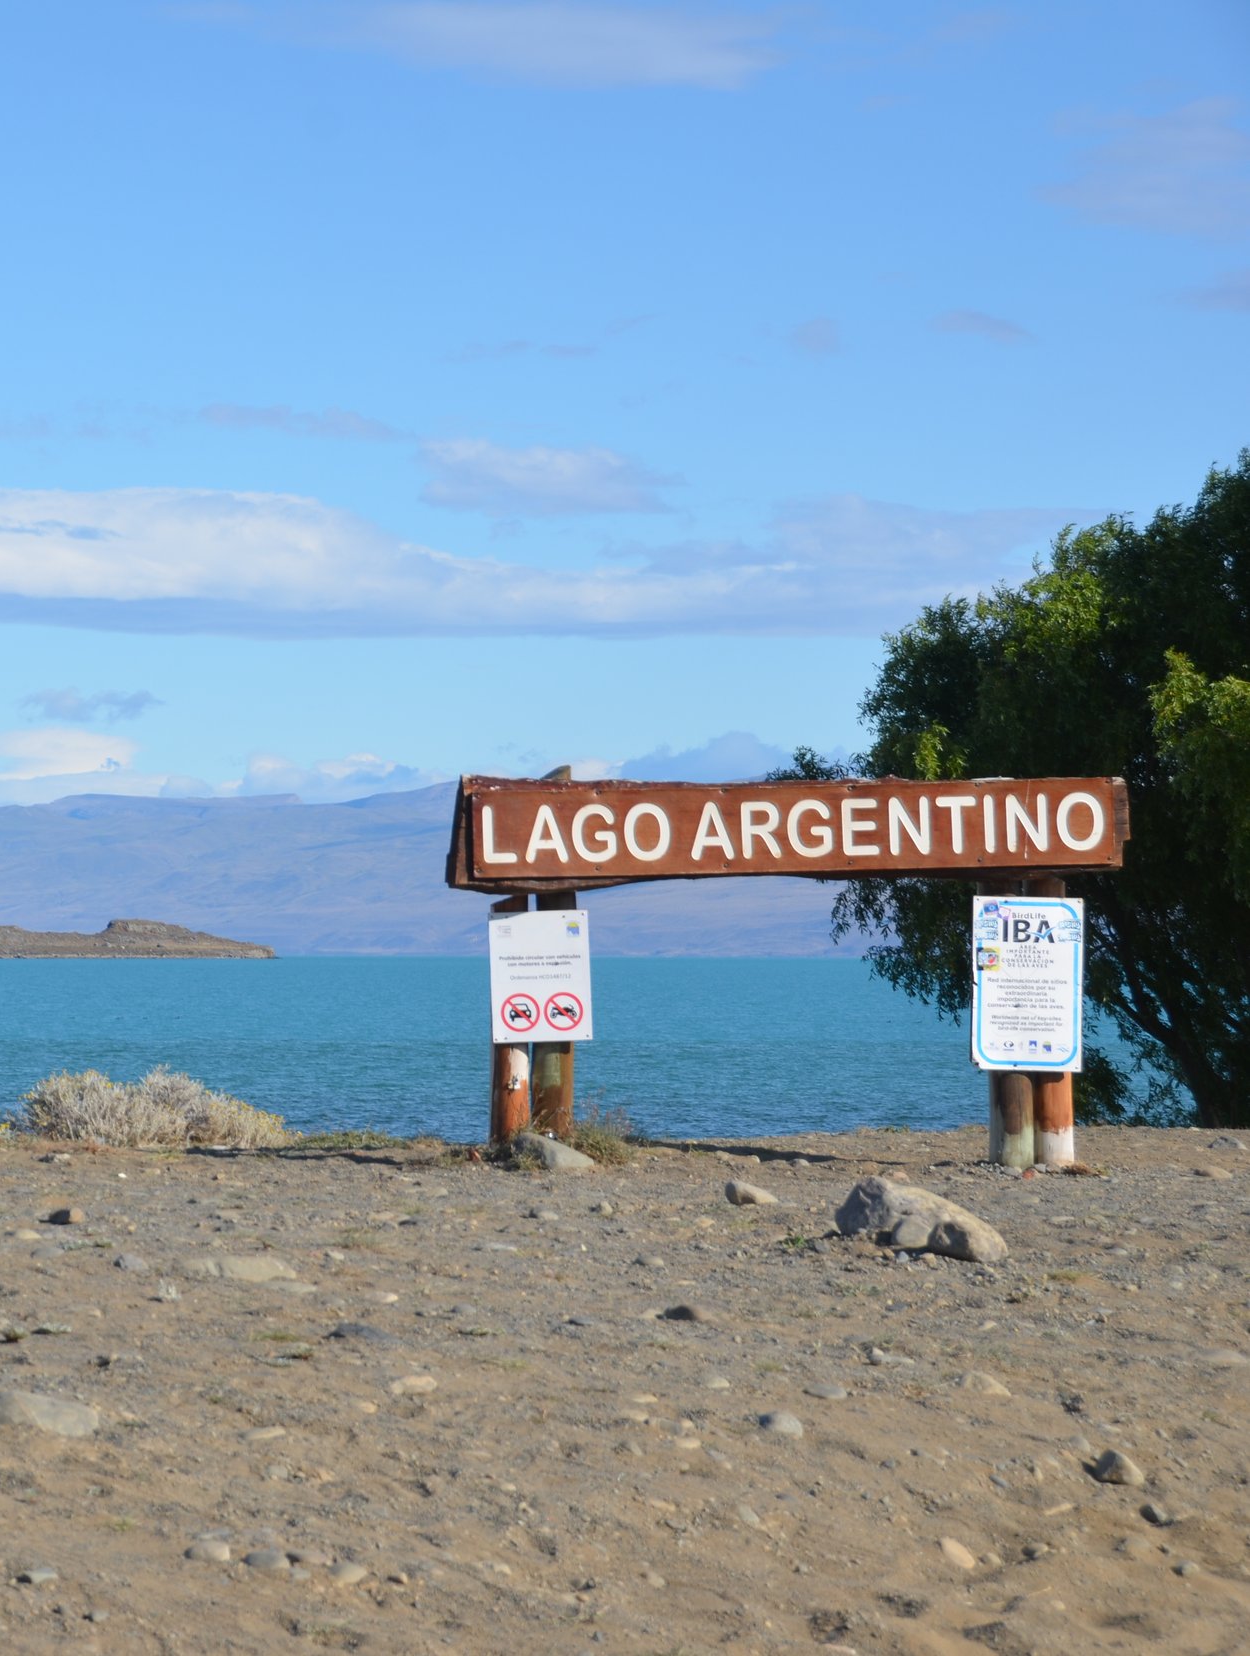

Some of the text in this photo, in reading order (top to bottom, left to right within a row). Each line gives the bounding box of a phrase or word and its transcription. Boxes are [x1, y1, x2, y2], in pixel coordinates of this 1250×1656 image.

[481, 790, 1106, 865] LAGO ARGENTINO
[1002, 919, 1055, 944] IBA
